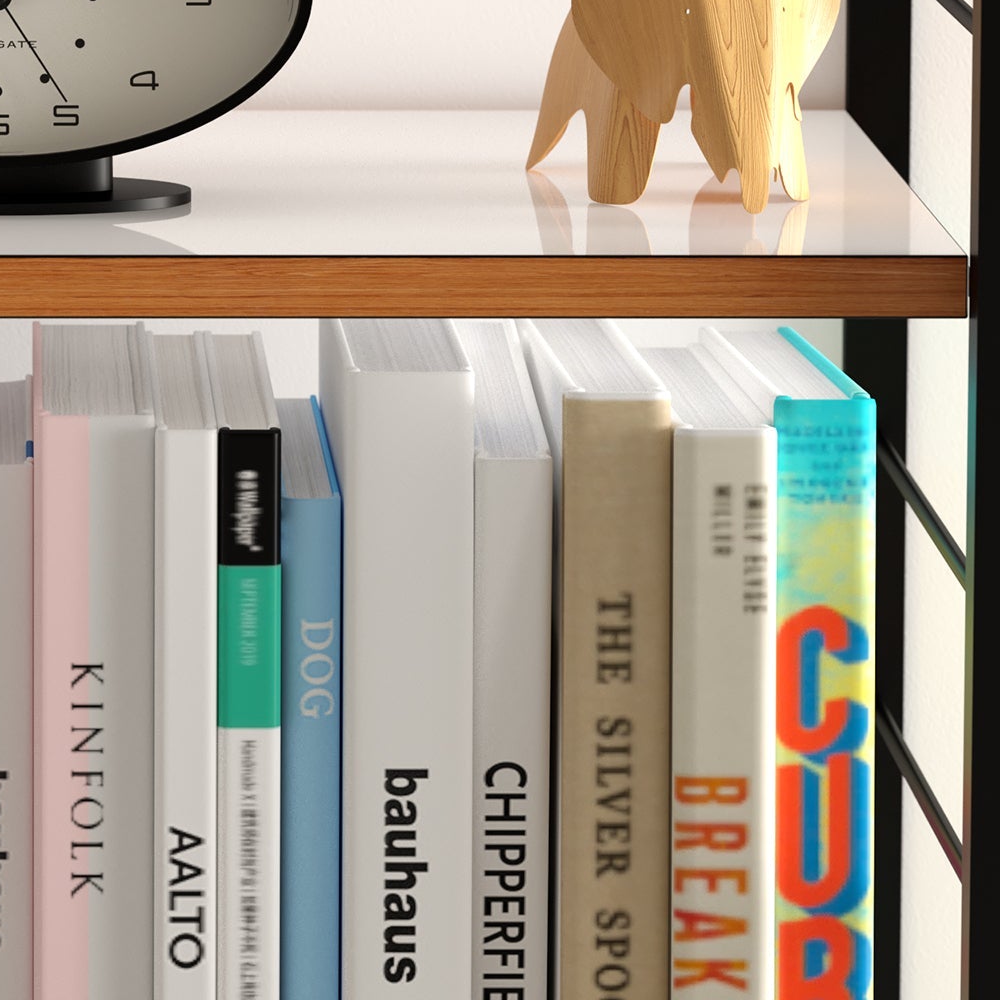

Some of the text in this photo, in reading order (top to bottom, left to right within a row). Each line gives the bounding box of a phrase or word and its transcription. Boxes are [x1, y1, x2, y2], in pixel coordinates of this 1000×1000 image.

[53, 105, 80, 127] 5
[130, 70, 159, 91] 4
[299, 618, 334, 719] DOG
[70, 663, 104, 897] KINFOLK
[383, 768, 429, 984] bauhaus
[483, 761, 528, 1000] CHIPPERFIE
[595, 592, 633, 1000] THE SILVER SPO
[673, 776, 749, 992] BREAK
[168, 826, 205, 969] AALTO
